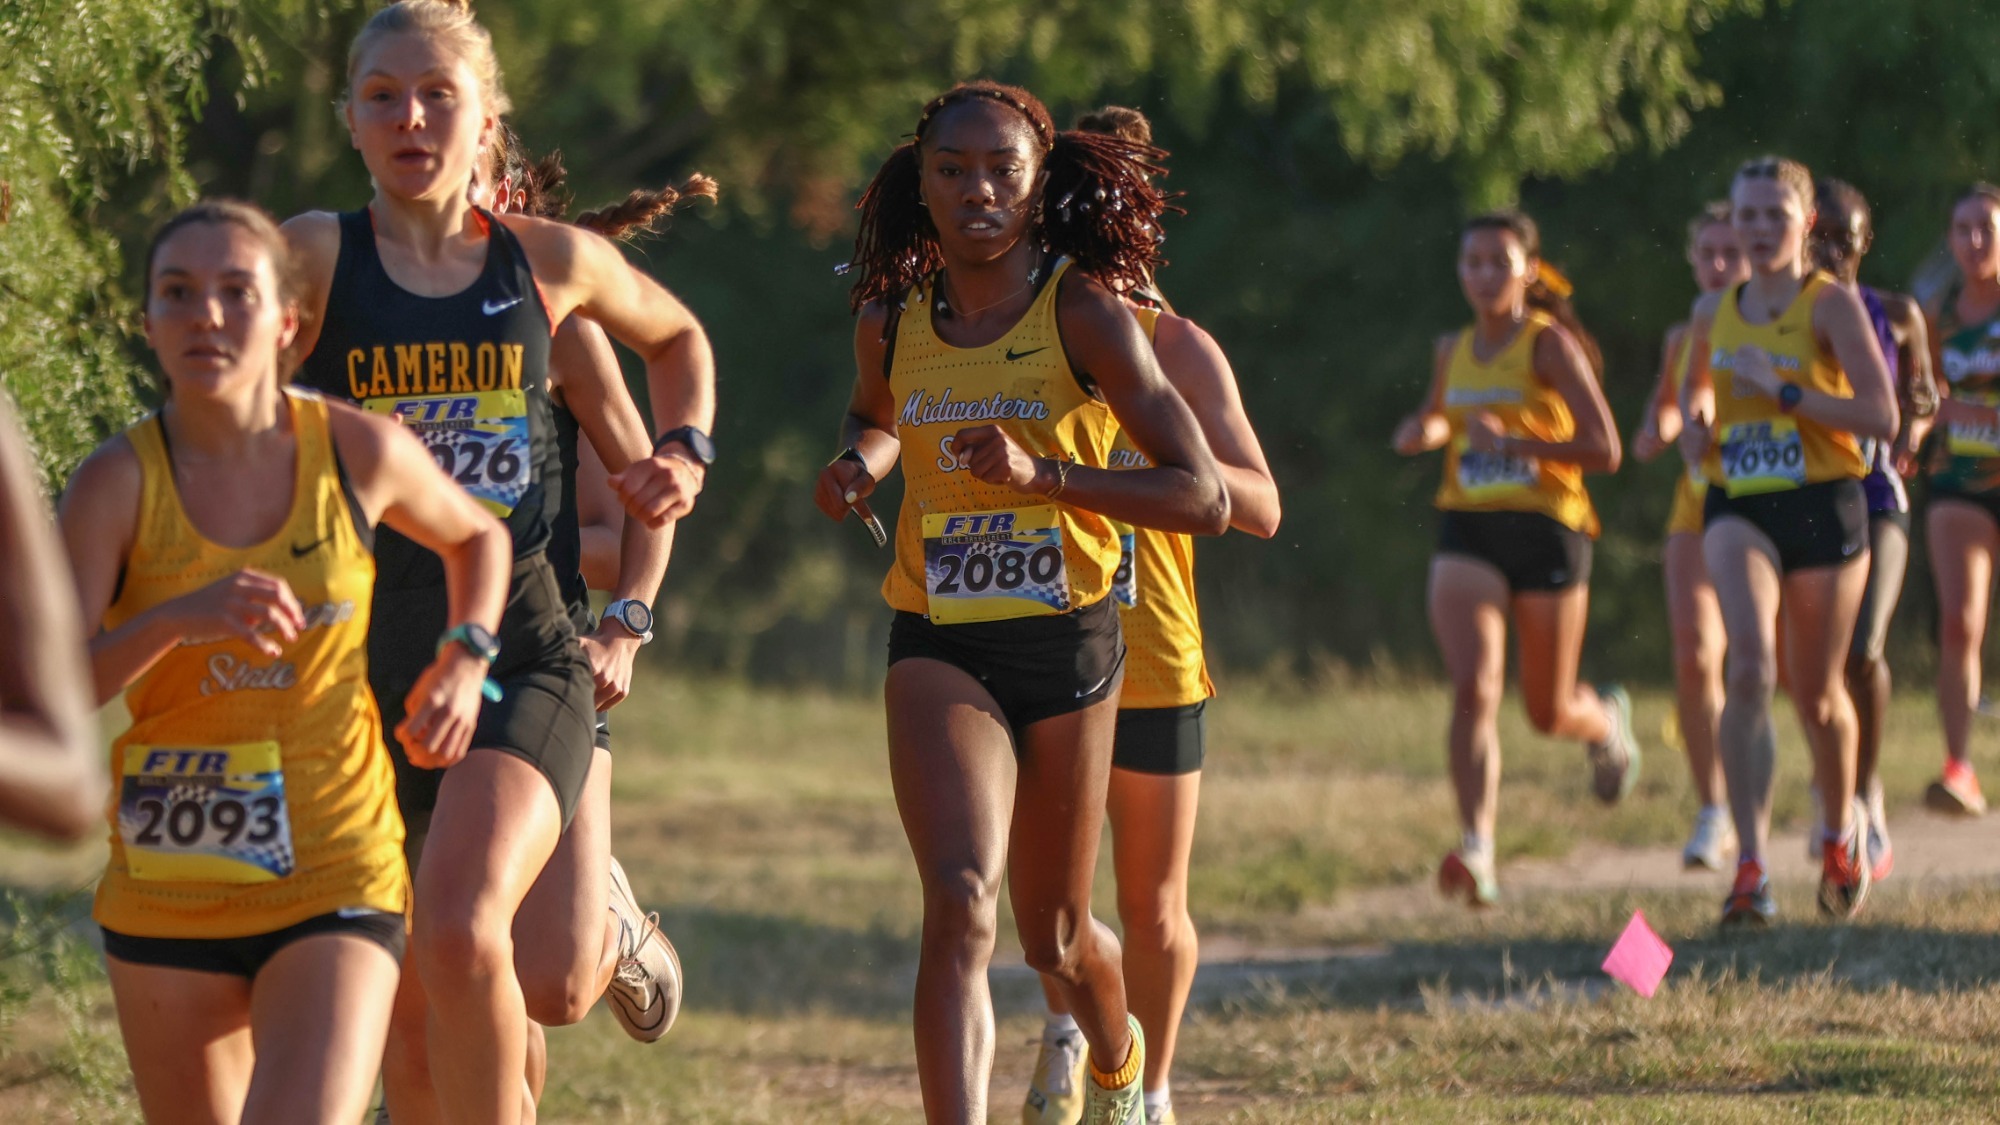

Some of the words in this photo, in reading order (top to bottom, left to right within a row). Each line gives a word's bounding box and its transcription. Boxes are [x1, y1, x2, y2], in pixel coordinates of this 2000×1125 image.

[347, 342, 524, 398] CAMERON
[392, 397, 479, 421] FTR
[898, 387, 1049, 427] Midwestern
[428, 438, 521, 485] 026
[942, 512, 1016, 537] FTR
[935, 545, 1062, 595] 2080
[201, 653, 298, 697] State
[142, 750, 231, 774] FTR
[135, 796, 280, 847] 2093
